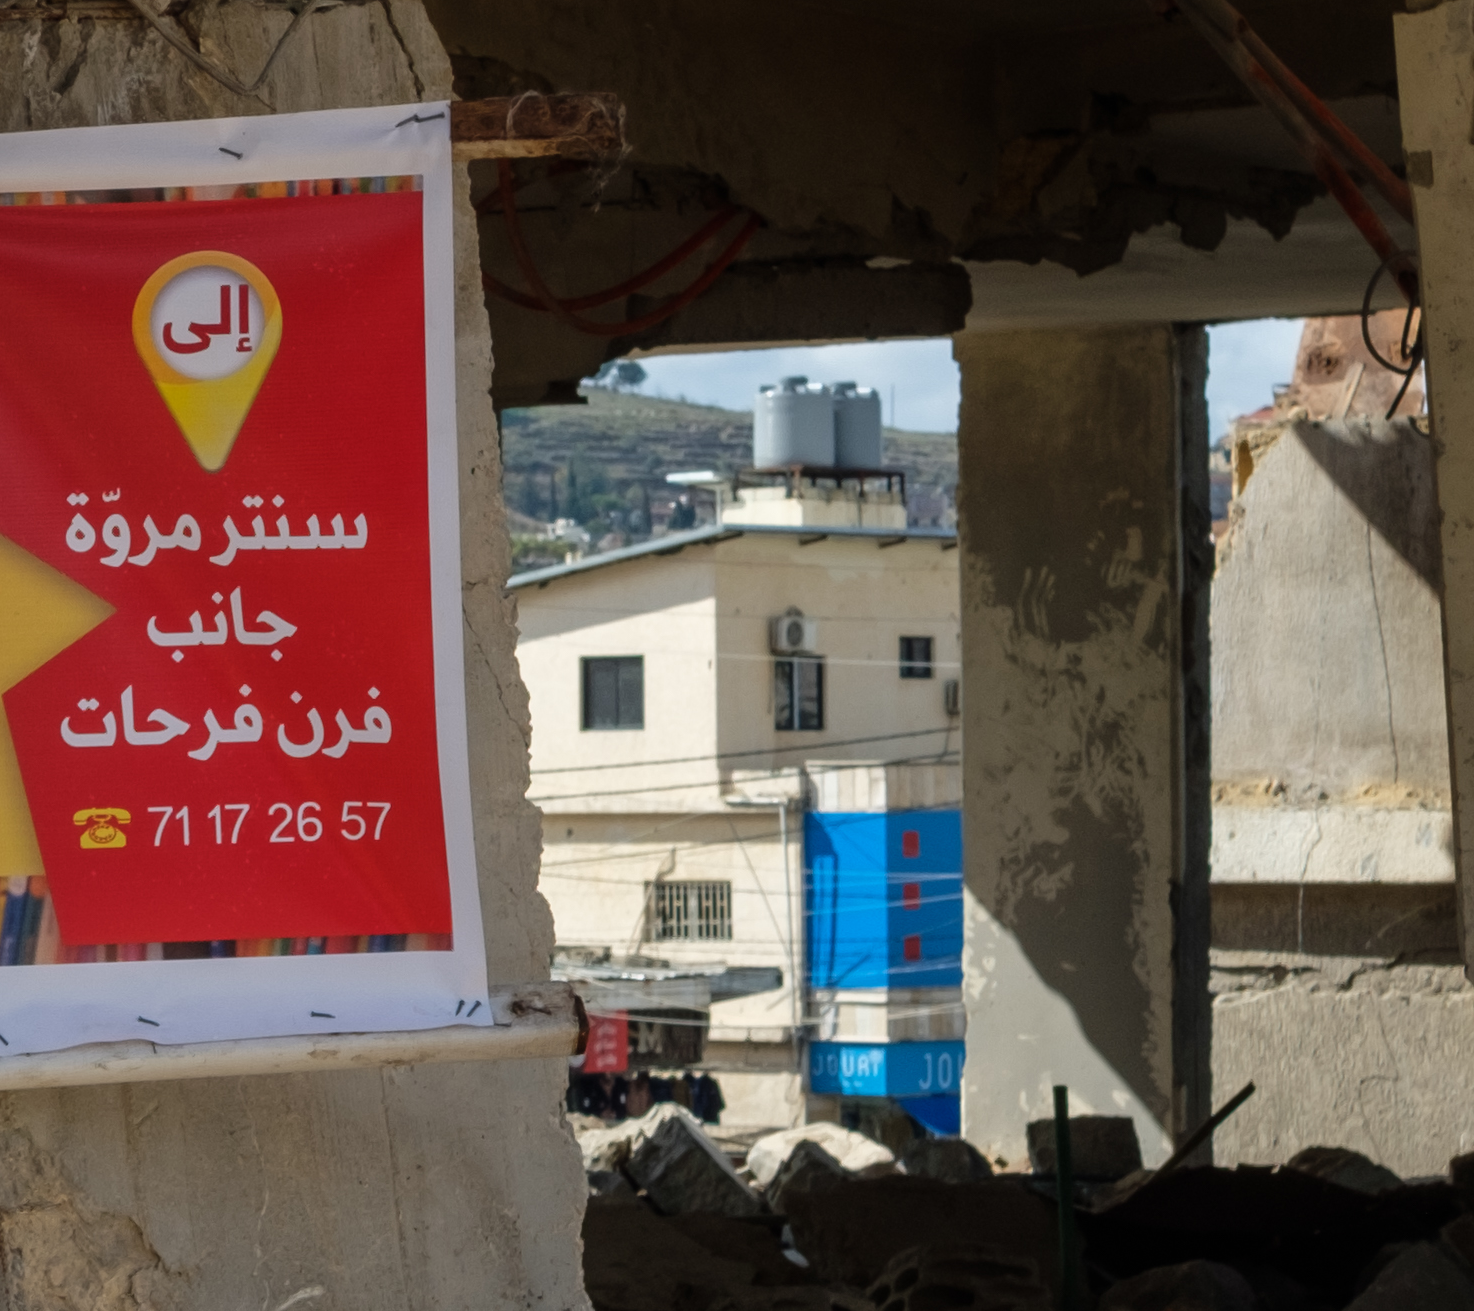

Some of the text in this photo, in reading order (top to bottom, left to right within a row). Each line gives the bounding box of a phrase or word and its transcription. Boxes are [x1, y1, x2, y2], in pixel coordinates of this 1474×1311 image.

[163, 284, 252, 354] إلى
[209, 494, 369, 567] سنتر
[147, 586, 298, 662] جانب
[60, 684, 393, 762] فرن فرحات
[147, 801, 392, 847] 71 17 26 57
[918, 1051, 966, 1090] JO
